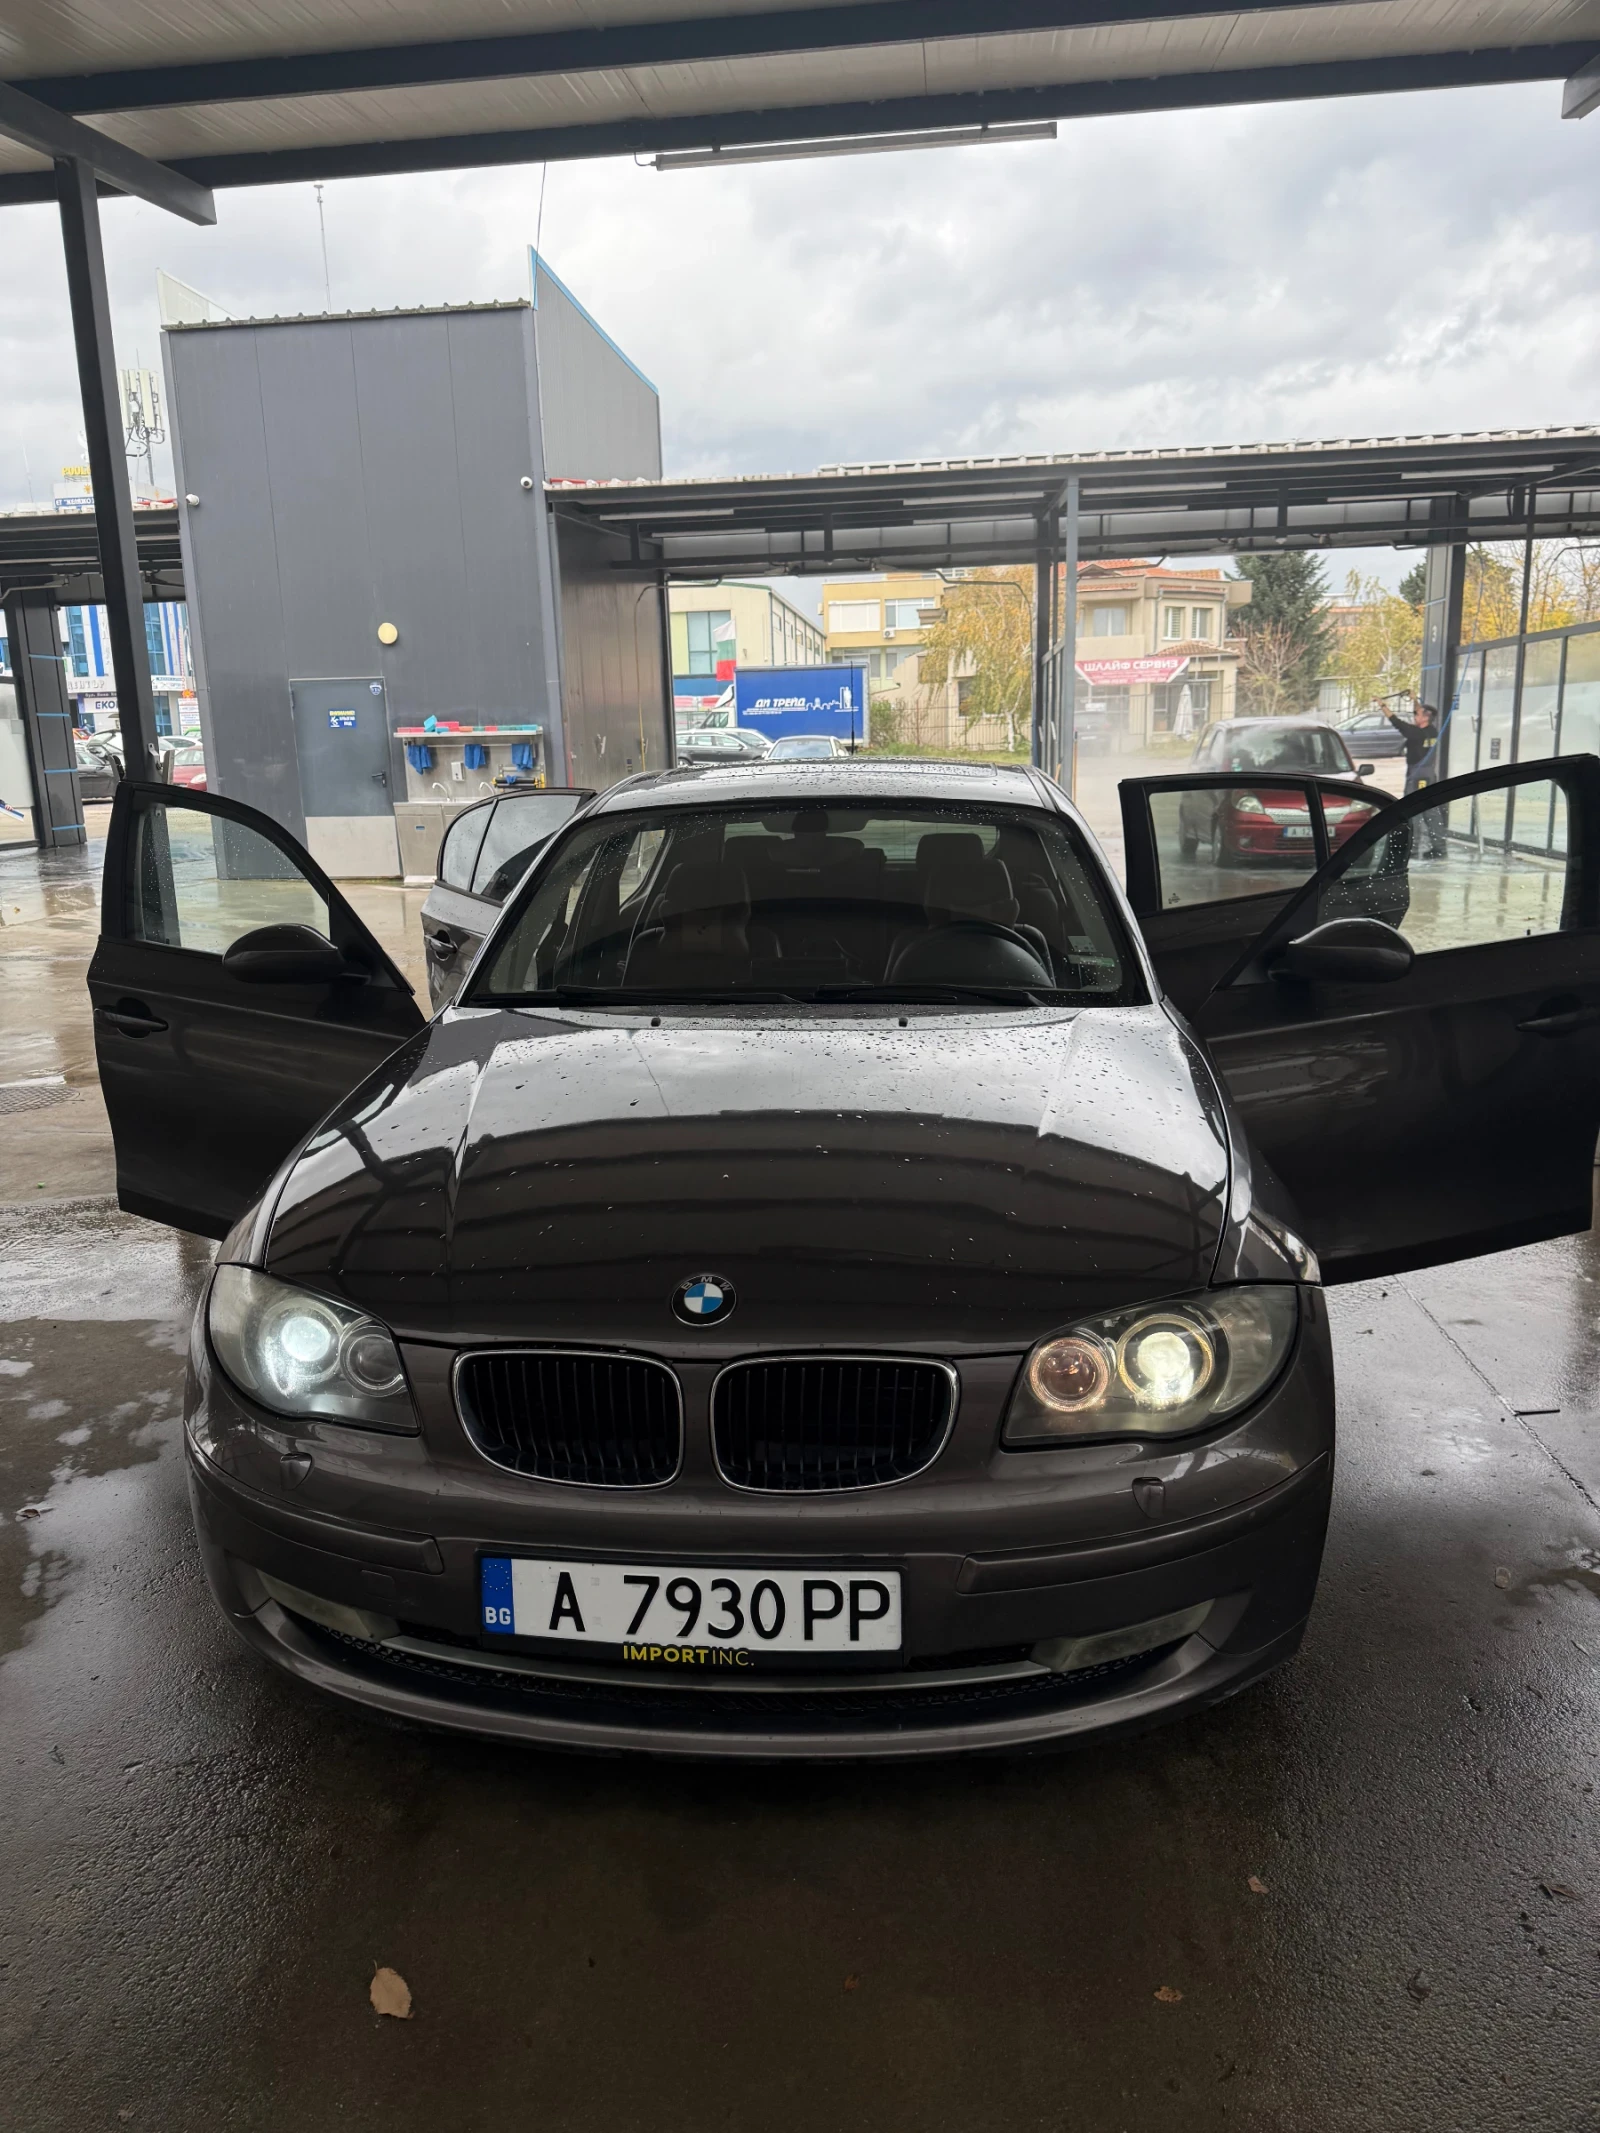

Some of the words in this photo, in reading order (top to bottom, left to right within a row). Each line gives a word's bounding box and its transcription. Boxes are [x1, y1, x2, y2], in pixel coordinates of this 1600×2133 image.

[1431, 625, 1438, 643] 3
[1084, 660, 1131, 672] ШЛАЙФ
[1133, 659, 1178, 670] СЕРВИЗ
[773, 697, 806, 707] ТРЕЙД
[681, 1276, 732, 1291] BMW
[548, 1571, 586, 1632] A
[623, 1575, 786, 1640] 7930
[803, 1579, 891, 1642] PP
[485, 1606, 511, 1625] BG
